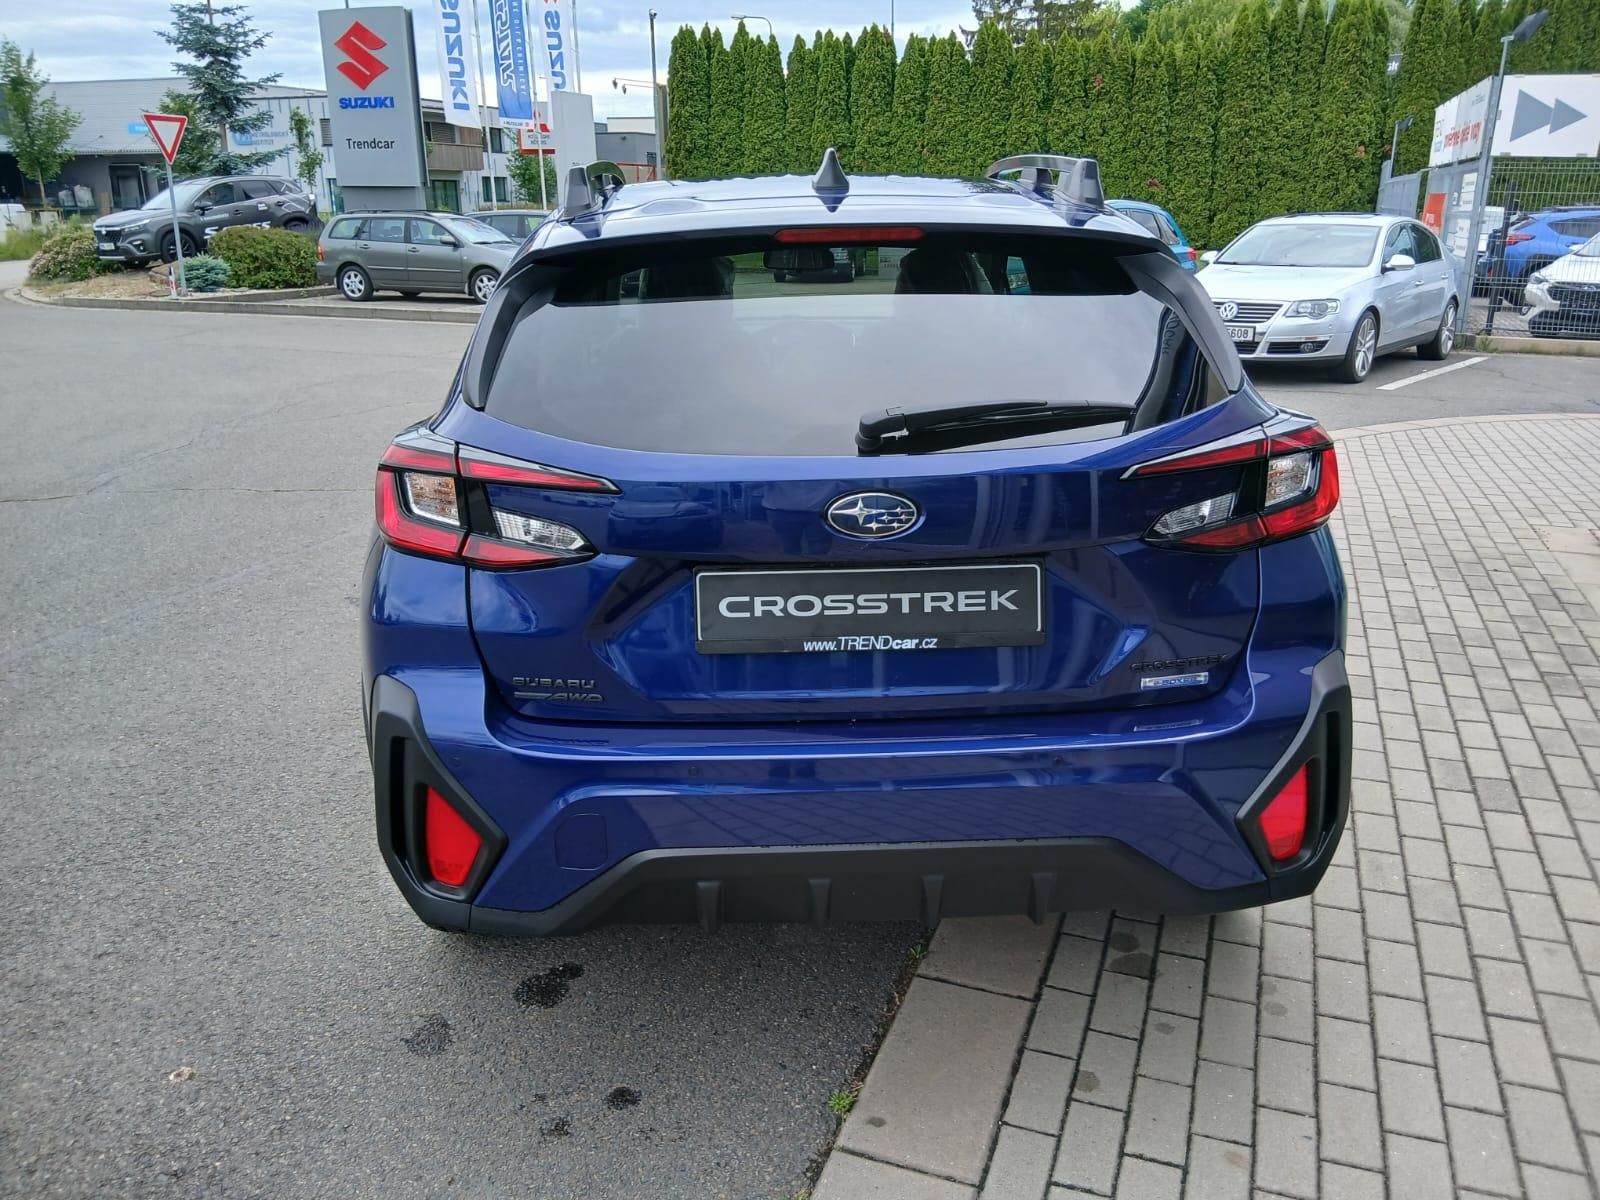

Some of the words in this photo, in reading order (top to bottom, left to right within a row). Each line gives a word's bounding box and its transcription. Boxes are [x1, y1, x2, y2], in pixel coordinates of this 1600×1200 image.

[339, 96, 395, 110] SUZUKI
[346, 138, 395, 150] Trendcar
[718, 589, 1020, 618] CROSSTREK
[803, 636, 938, 652] www.TRENDcar.cz
[512, 677, 595, 689] SUBARU
[547, 692, 604, 702] AWD
